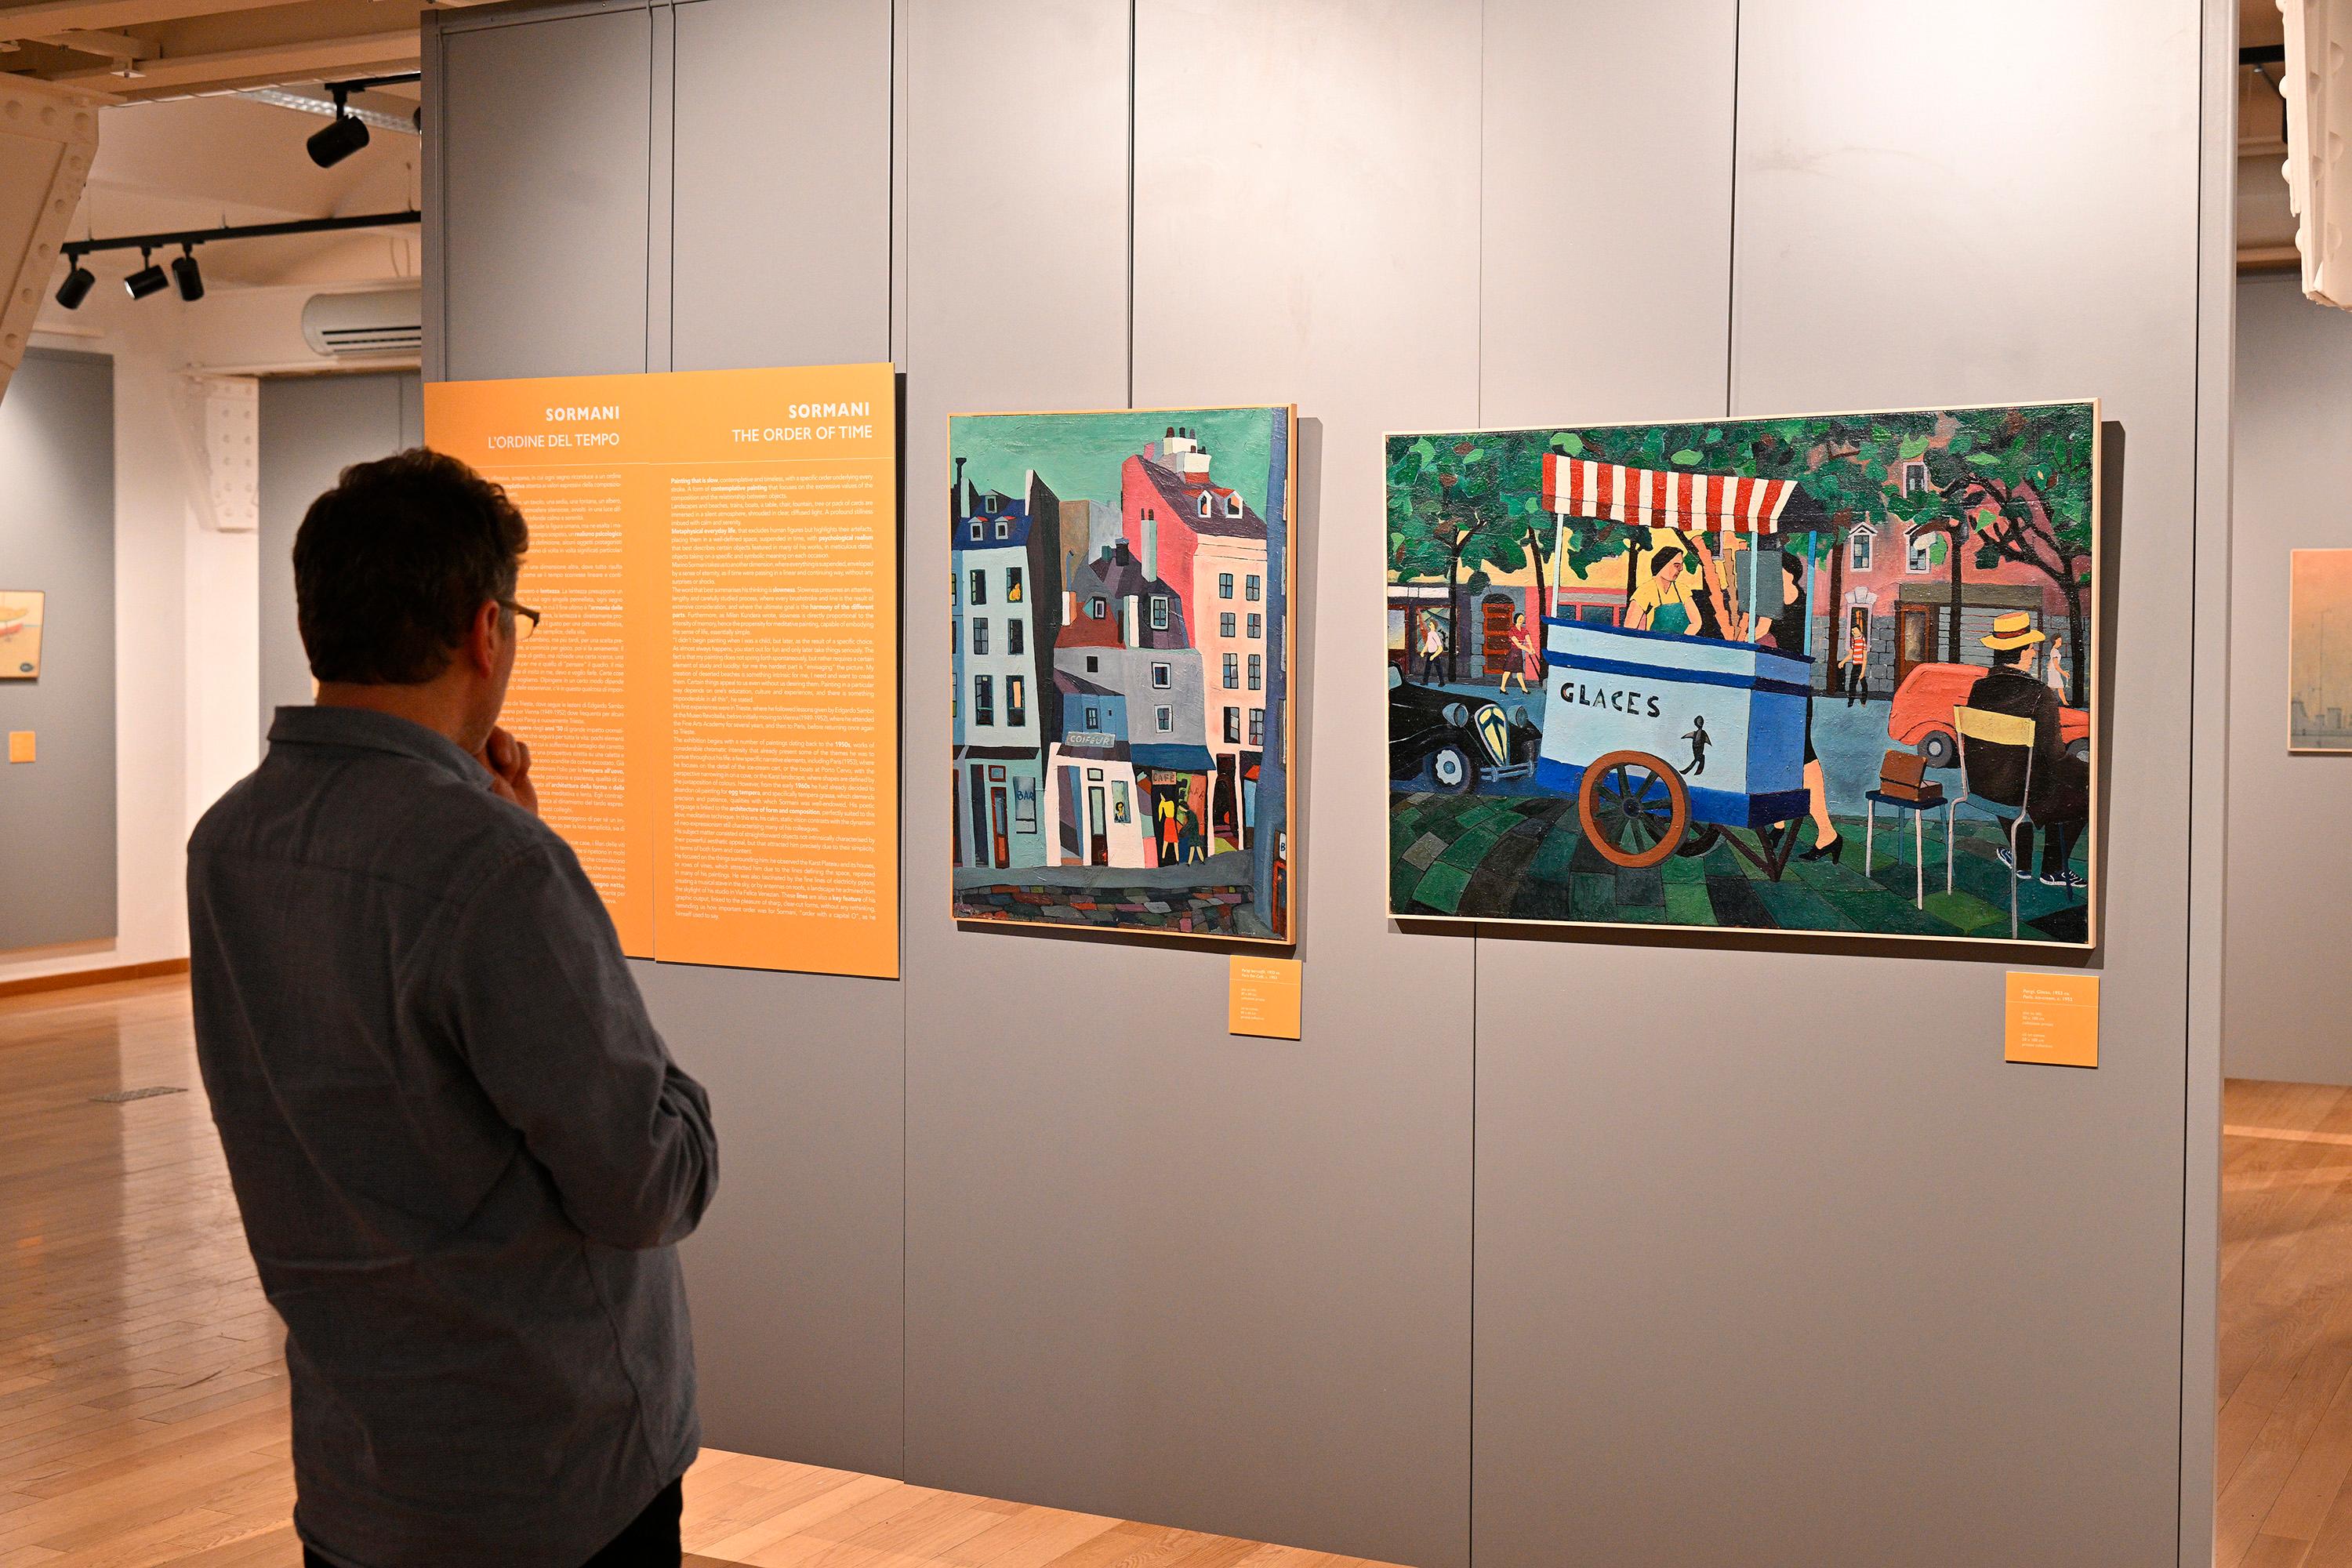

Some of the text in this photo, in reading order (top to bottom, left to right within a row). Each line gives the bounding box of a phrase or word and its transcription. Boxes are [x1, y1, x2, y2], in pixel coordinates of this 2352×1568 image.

[546, 405, 620, 422] SORMANI
[789, 401, 870, 419] SORMANI
[488, 432, 620, 449] L'ORDINE DEL TEMPO
[731, 424, 873, 442] THE ORDER OF TIME
[1559, 681, 1661, 718] GLACES
[1070, 735, 1109, 746] COIFEUR
[1017, 790, 1035, 801] BAR
[1281, 843, 1286, 851] B
